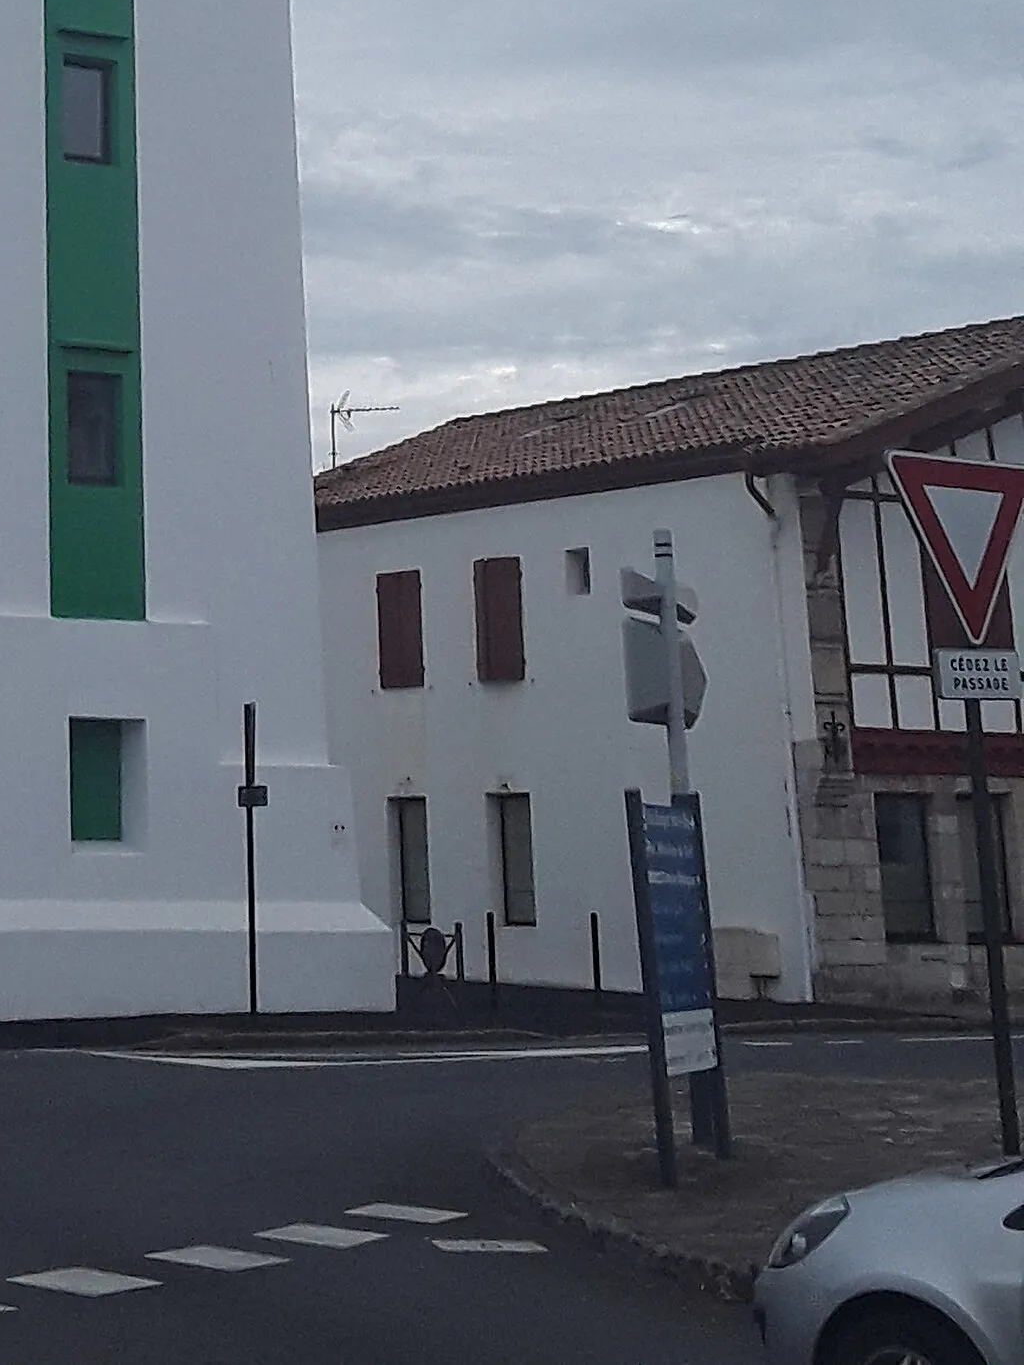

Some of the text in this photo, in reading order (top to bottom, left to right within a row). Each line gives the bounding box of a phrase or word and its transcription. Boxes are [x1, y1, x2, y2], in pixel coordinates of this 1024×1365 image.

[950, 655, 1008, 672] CÉDEZ LE
[953, 677, 1009, 691] PASSAGE
